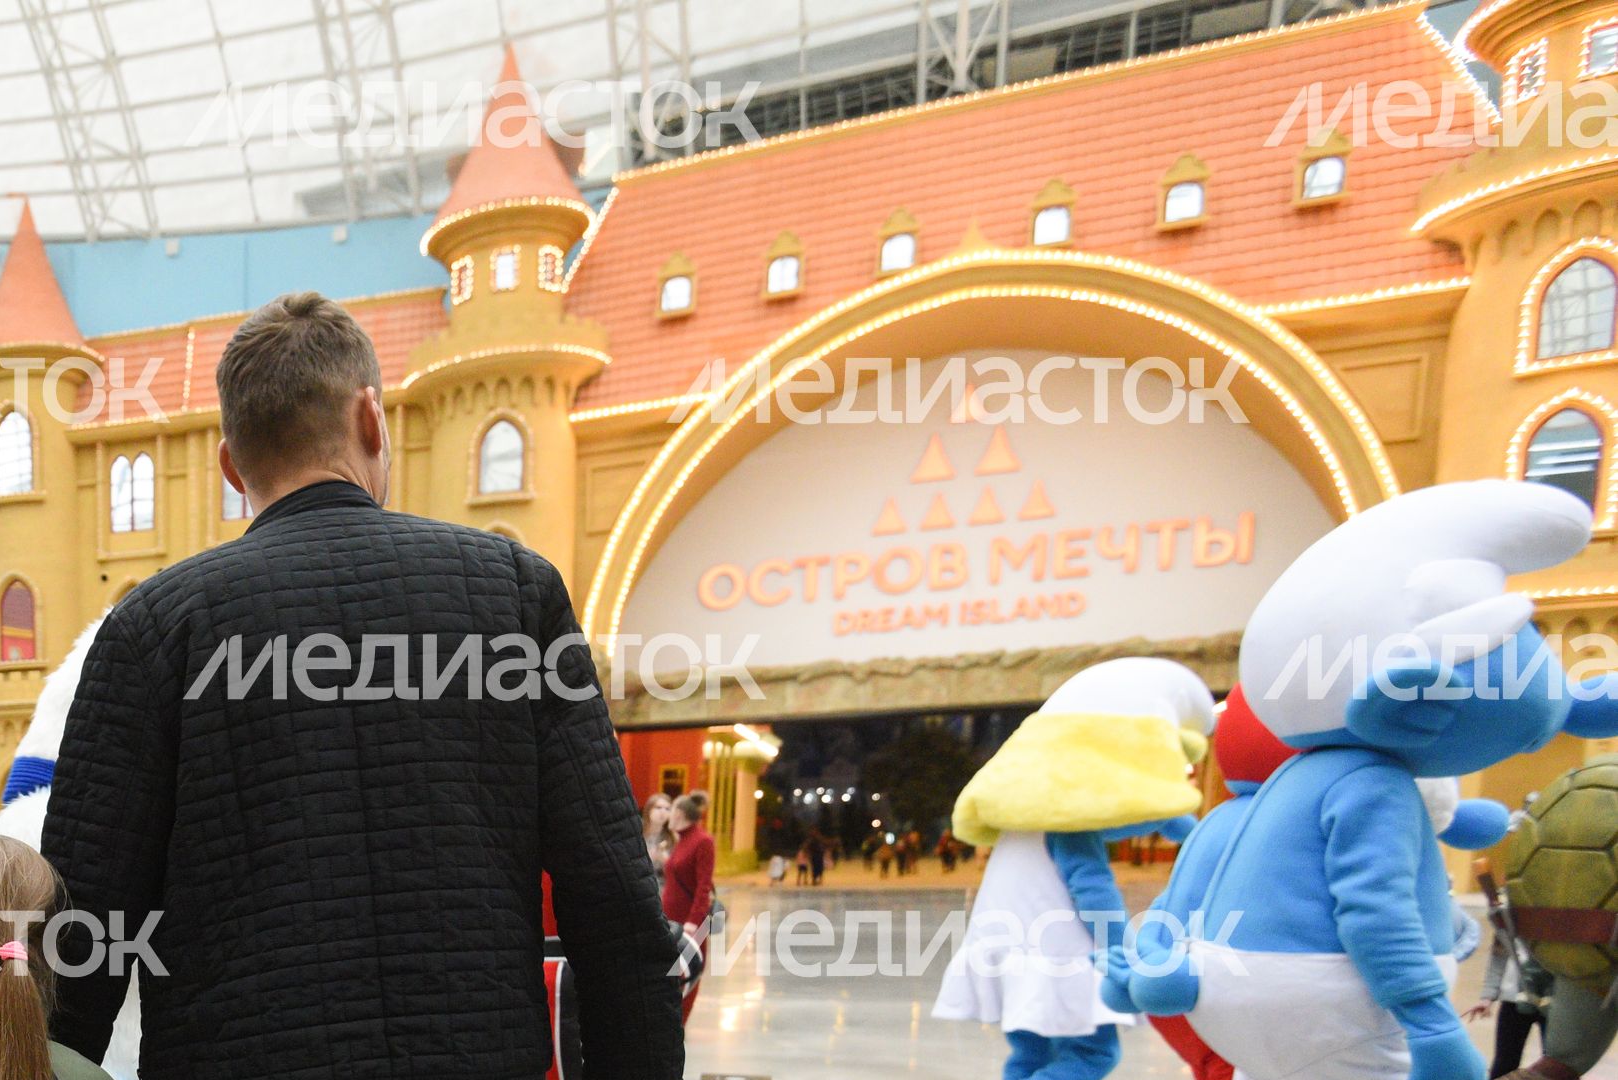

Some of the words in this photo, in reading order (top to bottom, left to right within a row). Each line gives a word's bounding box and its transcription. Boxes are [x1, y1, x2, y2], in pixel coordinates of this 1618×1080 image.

[696, 542, 969, 612] ОСТРОВ
[988, 511, 1256, 586] МЕЧТЫ
[832, 603, 951, 637] DREAM
[957, 590, 1087, 626] ISLAND
